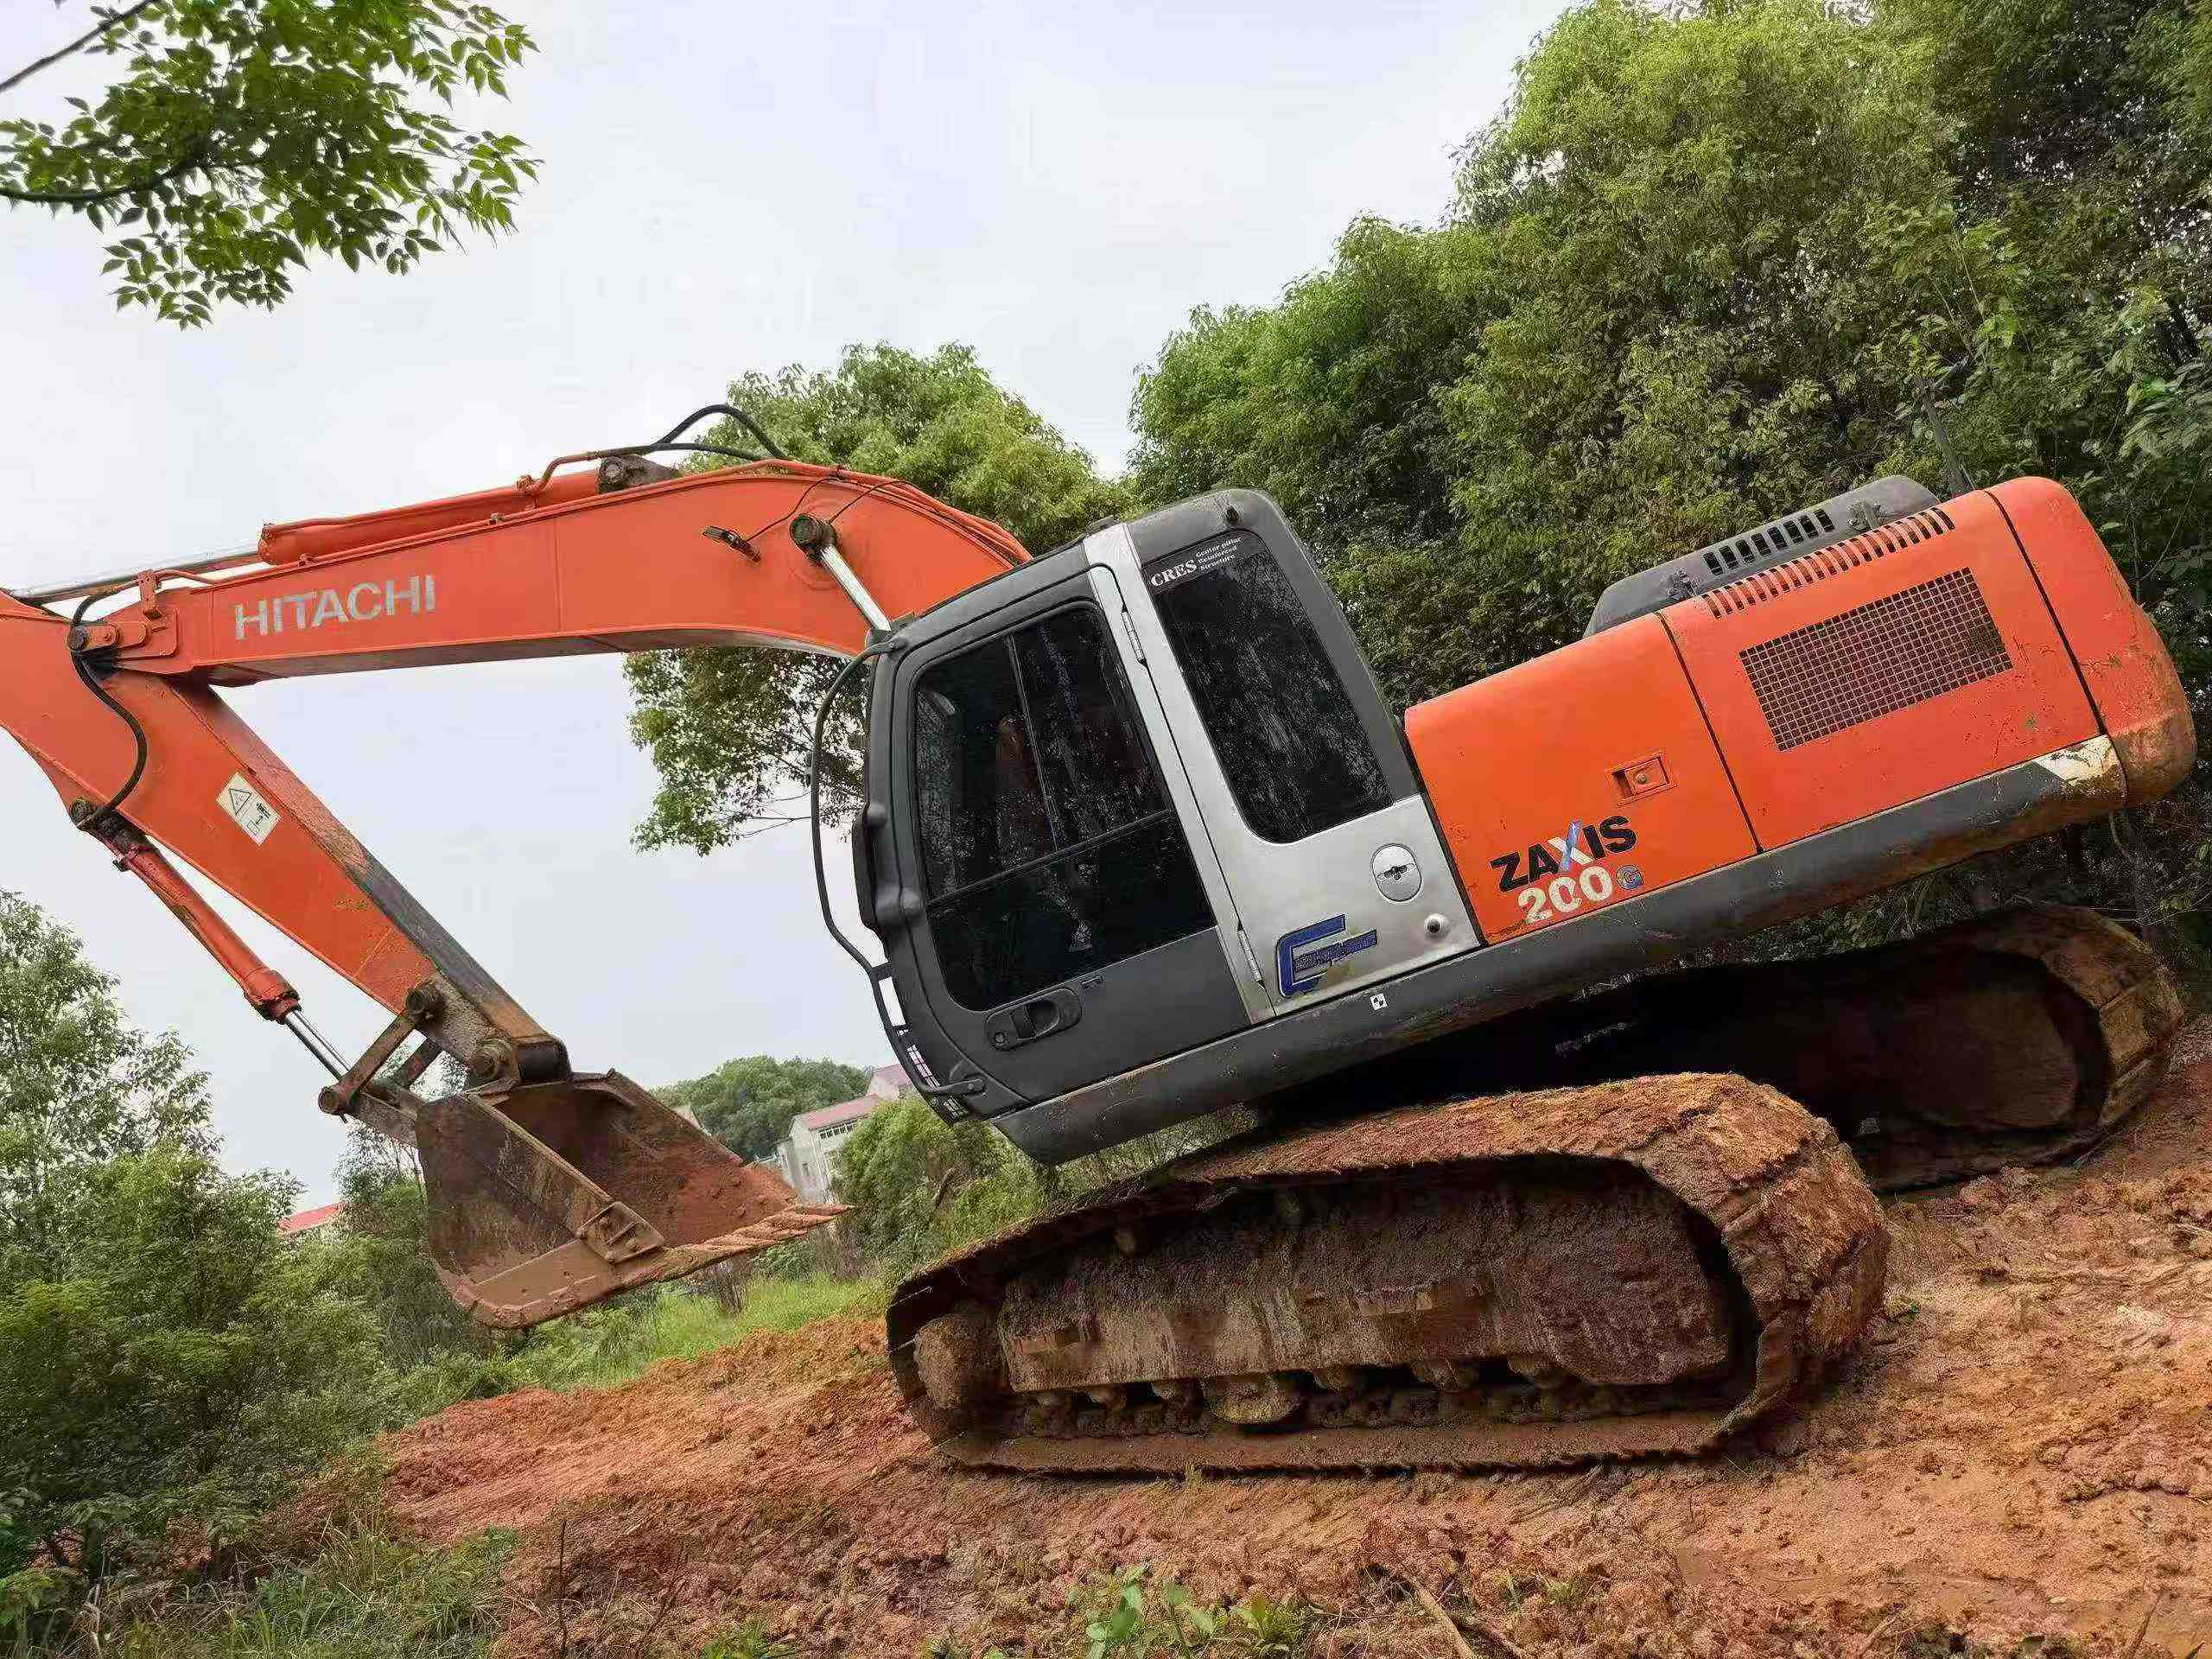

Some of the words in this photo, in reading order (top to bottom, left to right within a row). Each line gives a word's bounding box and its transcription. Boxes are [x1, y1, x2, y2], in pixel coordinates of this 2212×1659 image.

[1150, 559, 1197, 587] CRES
[234, 574, 436, 641] HITACHI
[1490, 815, 1638, 893] ZAXIS
